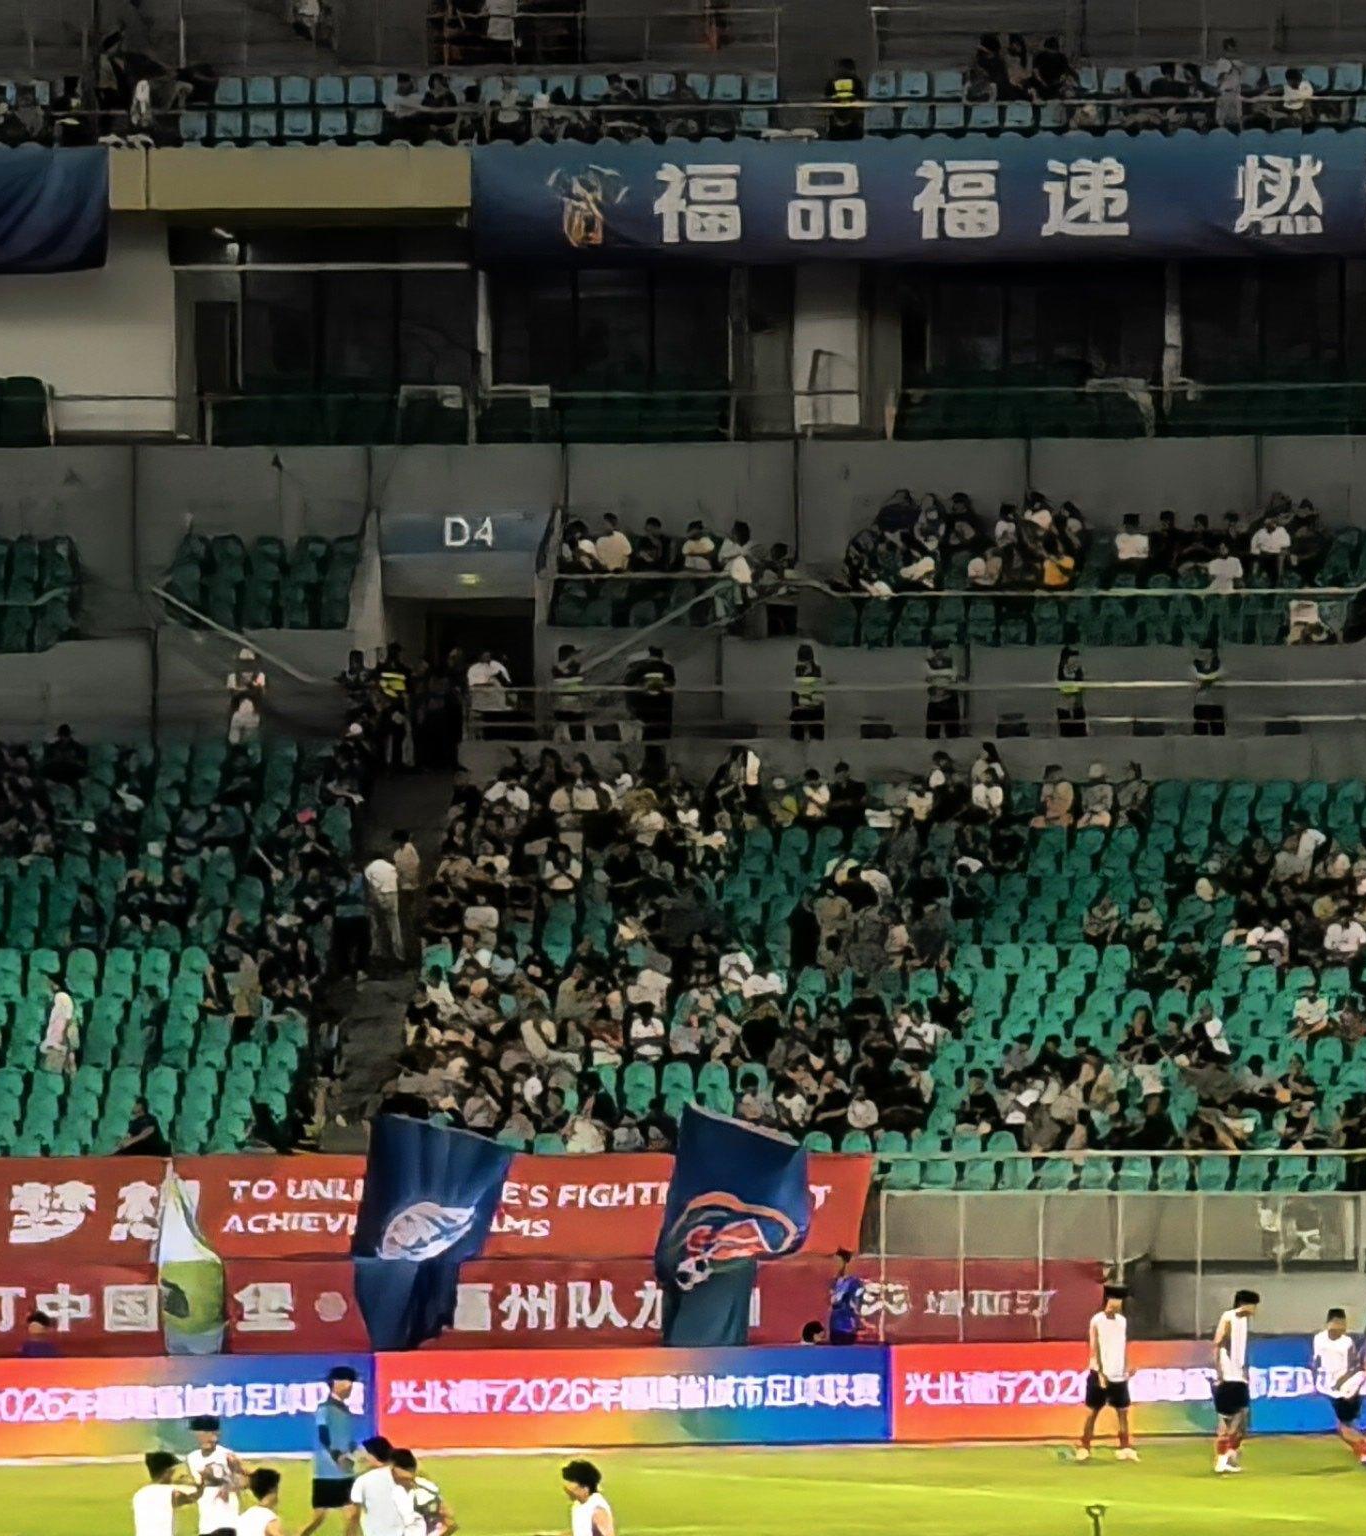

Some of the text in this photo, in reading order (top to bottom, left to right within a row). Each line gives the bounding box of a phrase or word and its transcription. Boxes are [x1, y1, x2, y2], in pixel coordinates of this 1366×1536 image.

[653, 156, 1131, 244] 福品福递
[443, 515, 494, 548] D4
[229, 1179, 278, 1202] TO
